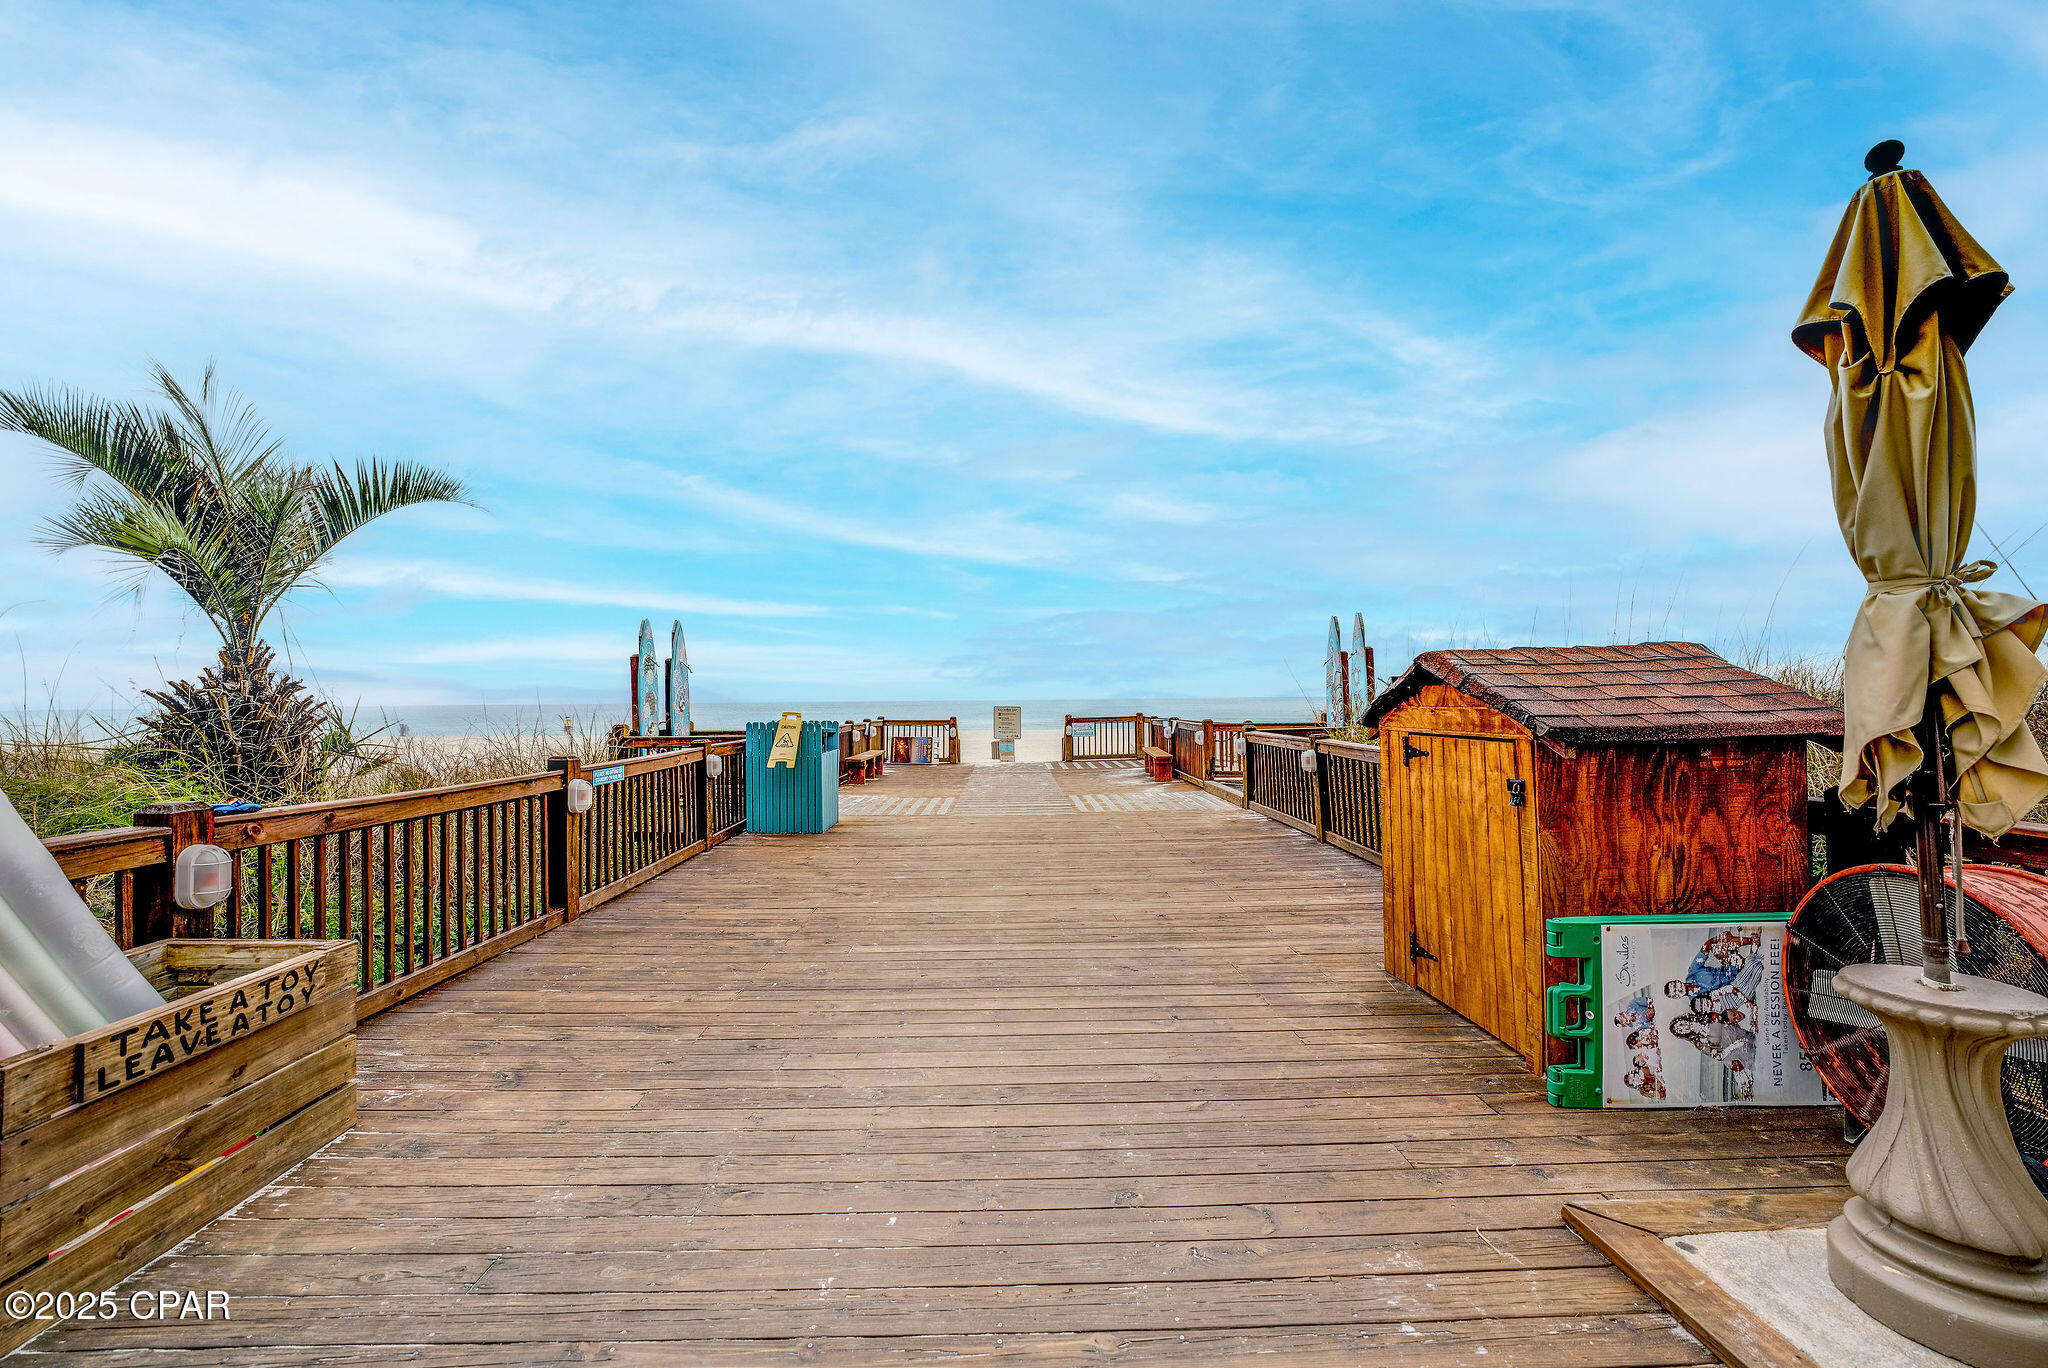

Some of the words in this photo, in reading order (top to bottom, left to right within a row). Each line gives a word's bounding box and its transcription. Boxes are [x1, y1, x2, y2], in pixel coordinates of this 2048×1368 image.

[1770, 938, 1780, 966] FEE!
[1770, 970, 1780, 1026] SESSION
[1772, 1030, 1780, 1039] A
[1772, 1043, 1783, 1086] NEVER
